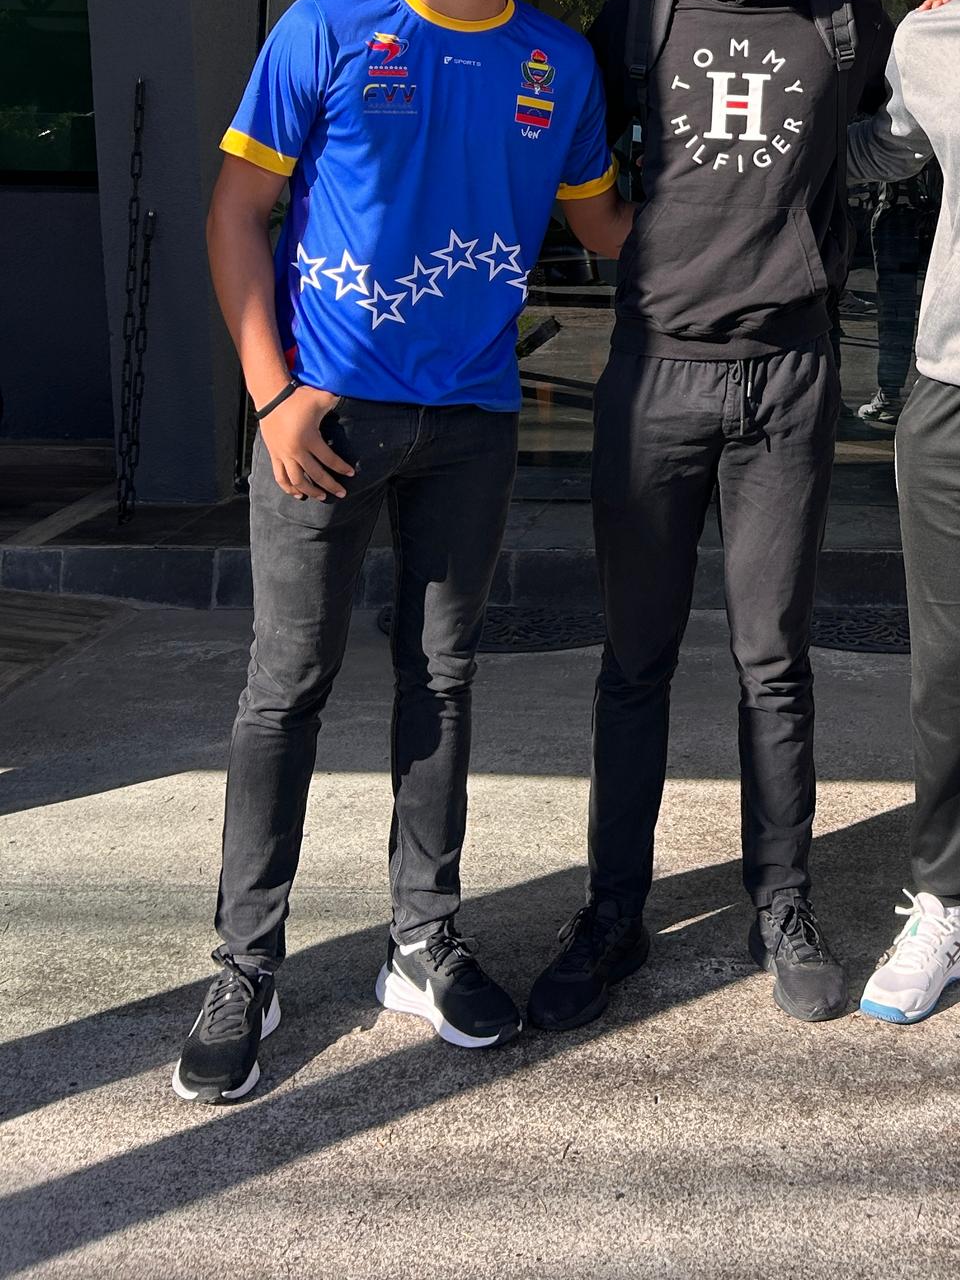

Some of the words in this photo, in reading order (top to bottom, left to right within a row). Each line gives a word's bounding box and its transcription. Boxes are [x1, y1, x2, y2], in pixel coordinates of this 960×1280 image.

[671, 38, 804, 94] TOMMY
[703, 71, 772, 141] H
[670, 114, 803, 173] HILFIGER
